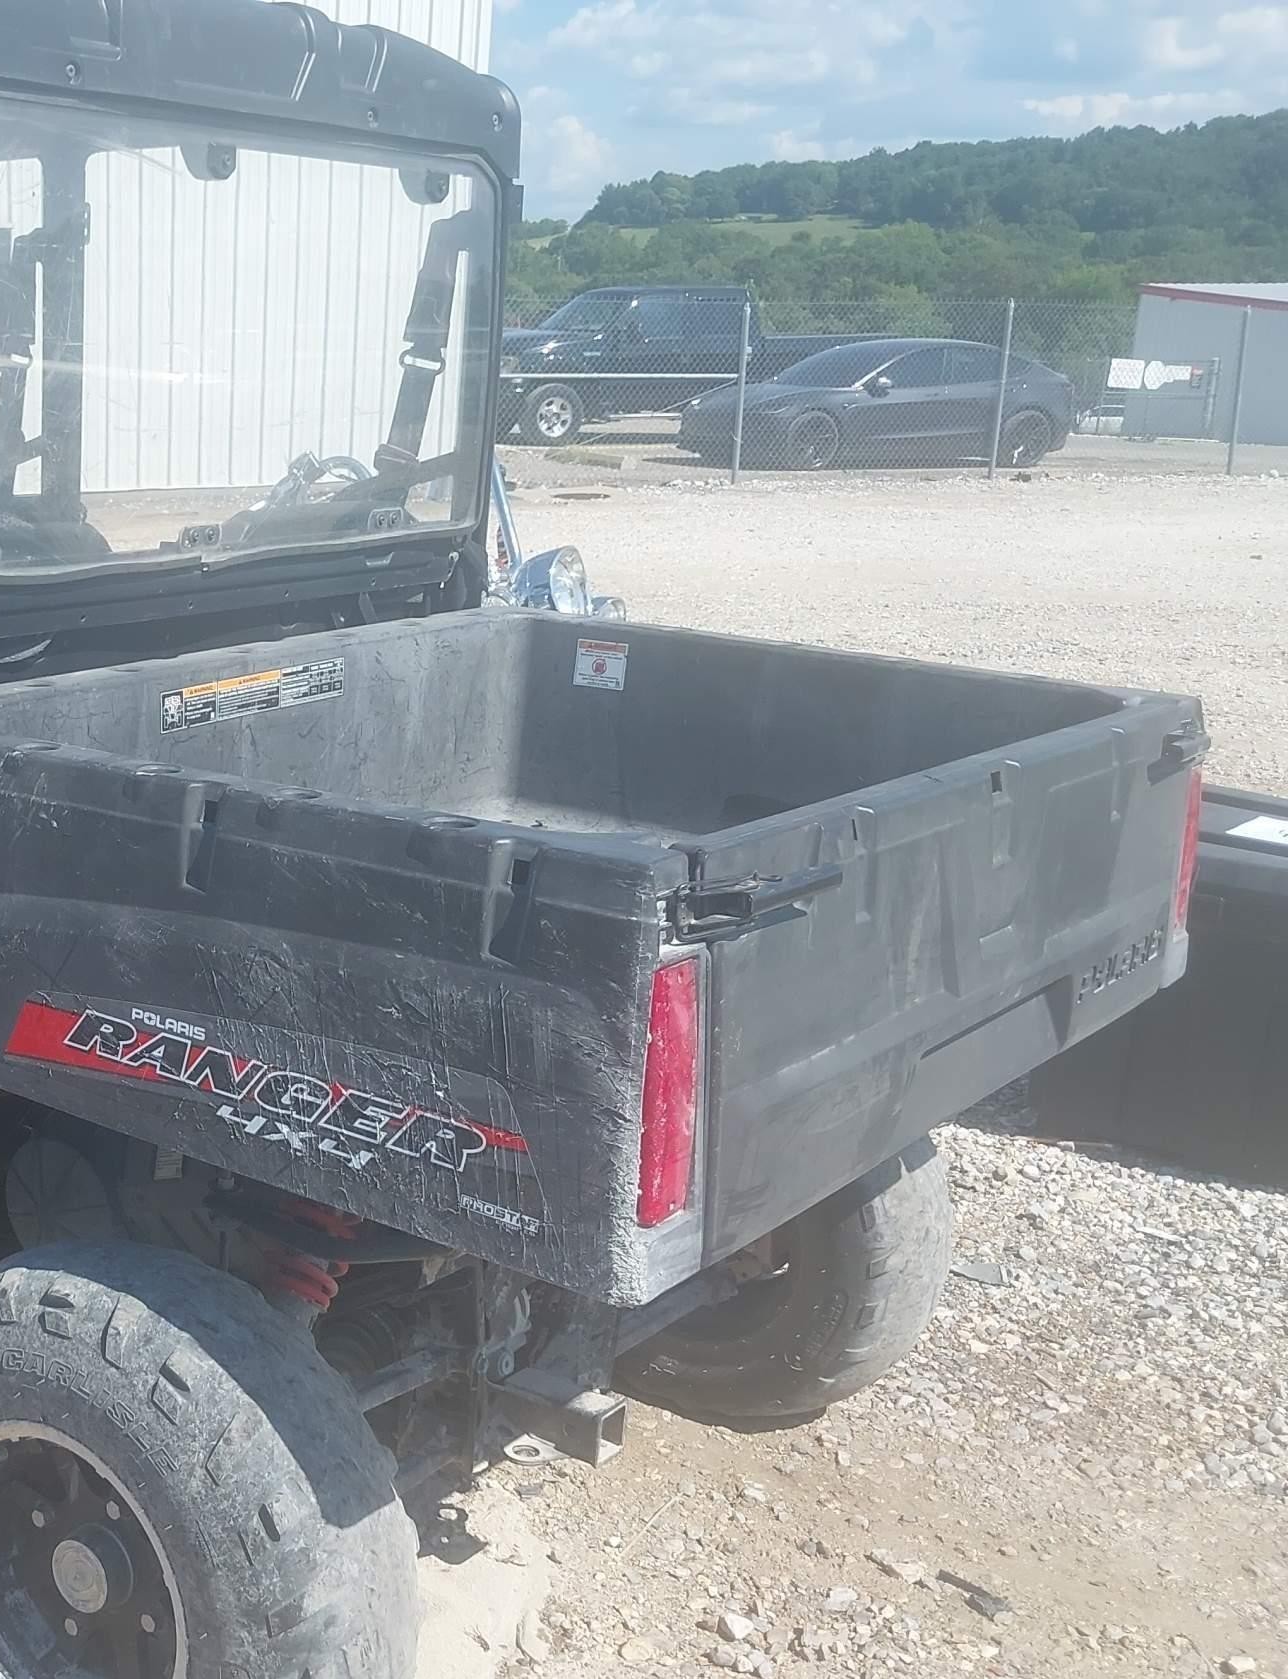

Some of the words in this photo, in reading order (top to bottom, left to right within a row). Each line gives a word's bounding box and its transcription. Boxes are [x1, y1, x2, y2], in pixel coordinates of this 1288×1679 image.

[131, 1007, 206, 1041] POLARIS
[63, 1008, 487, 1173] RANGER
[1, 1347, 180, 1478] CARLISLE
